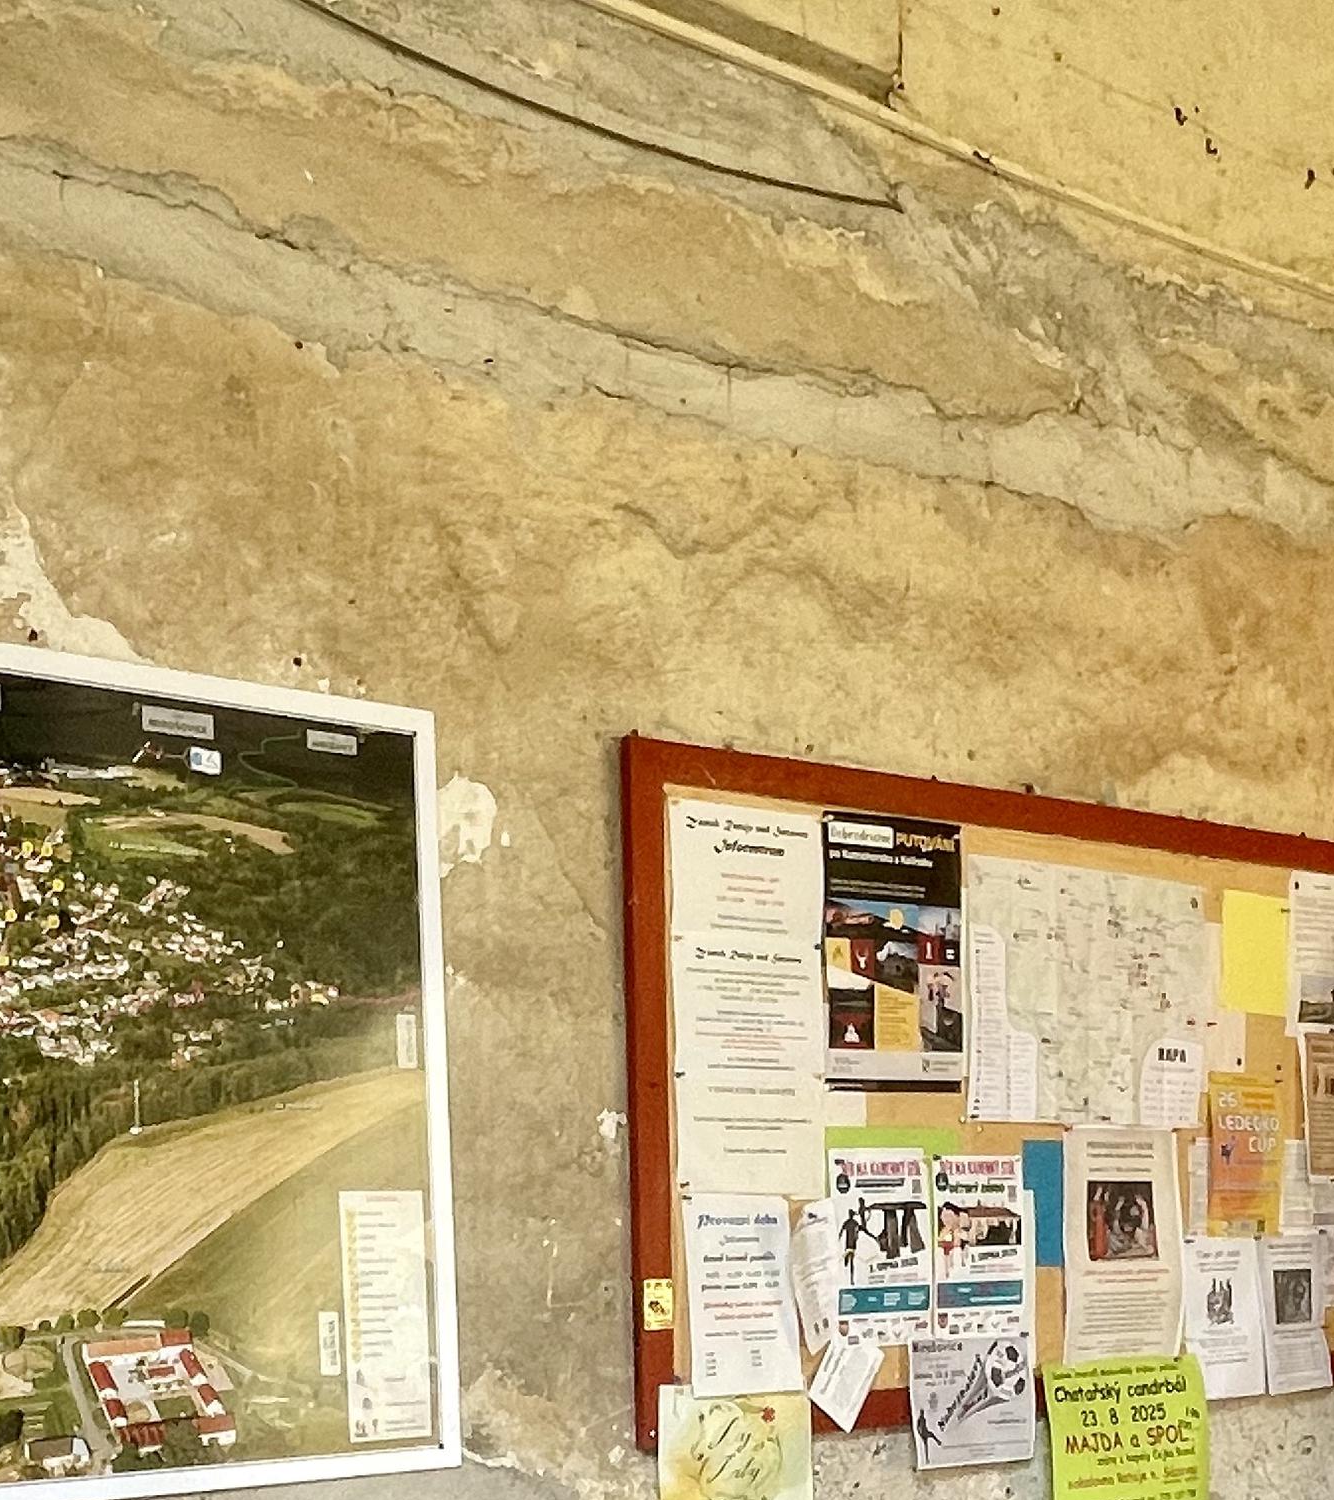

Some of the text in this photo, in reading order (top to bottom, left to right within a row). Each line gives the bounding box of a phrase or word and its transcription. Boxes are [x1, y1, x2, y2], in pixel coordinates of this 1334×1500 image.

[1130, 1402, 1166, 1422] 2025
[1065, 1432, 1123, 1454] MAJDA
[1130, 1434, 1140, 1447] a
